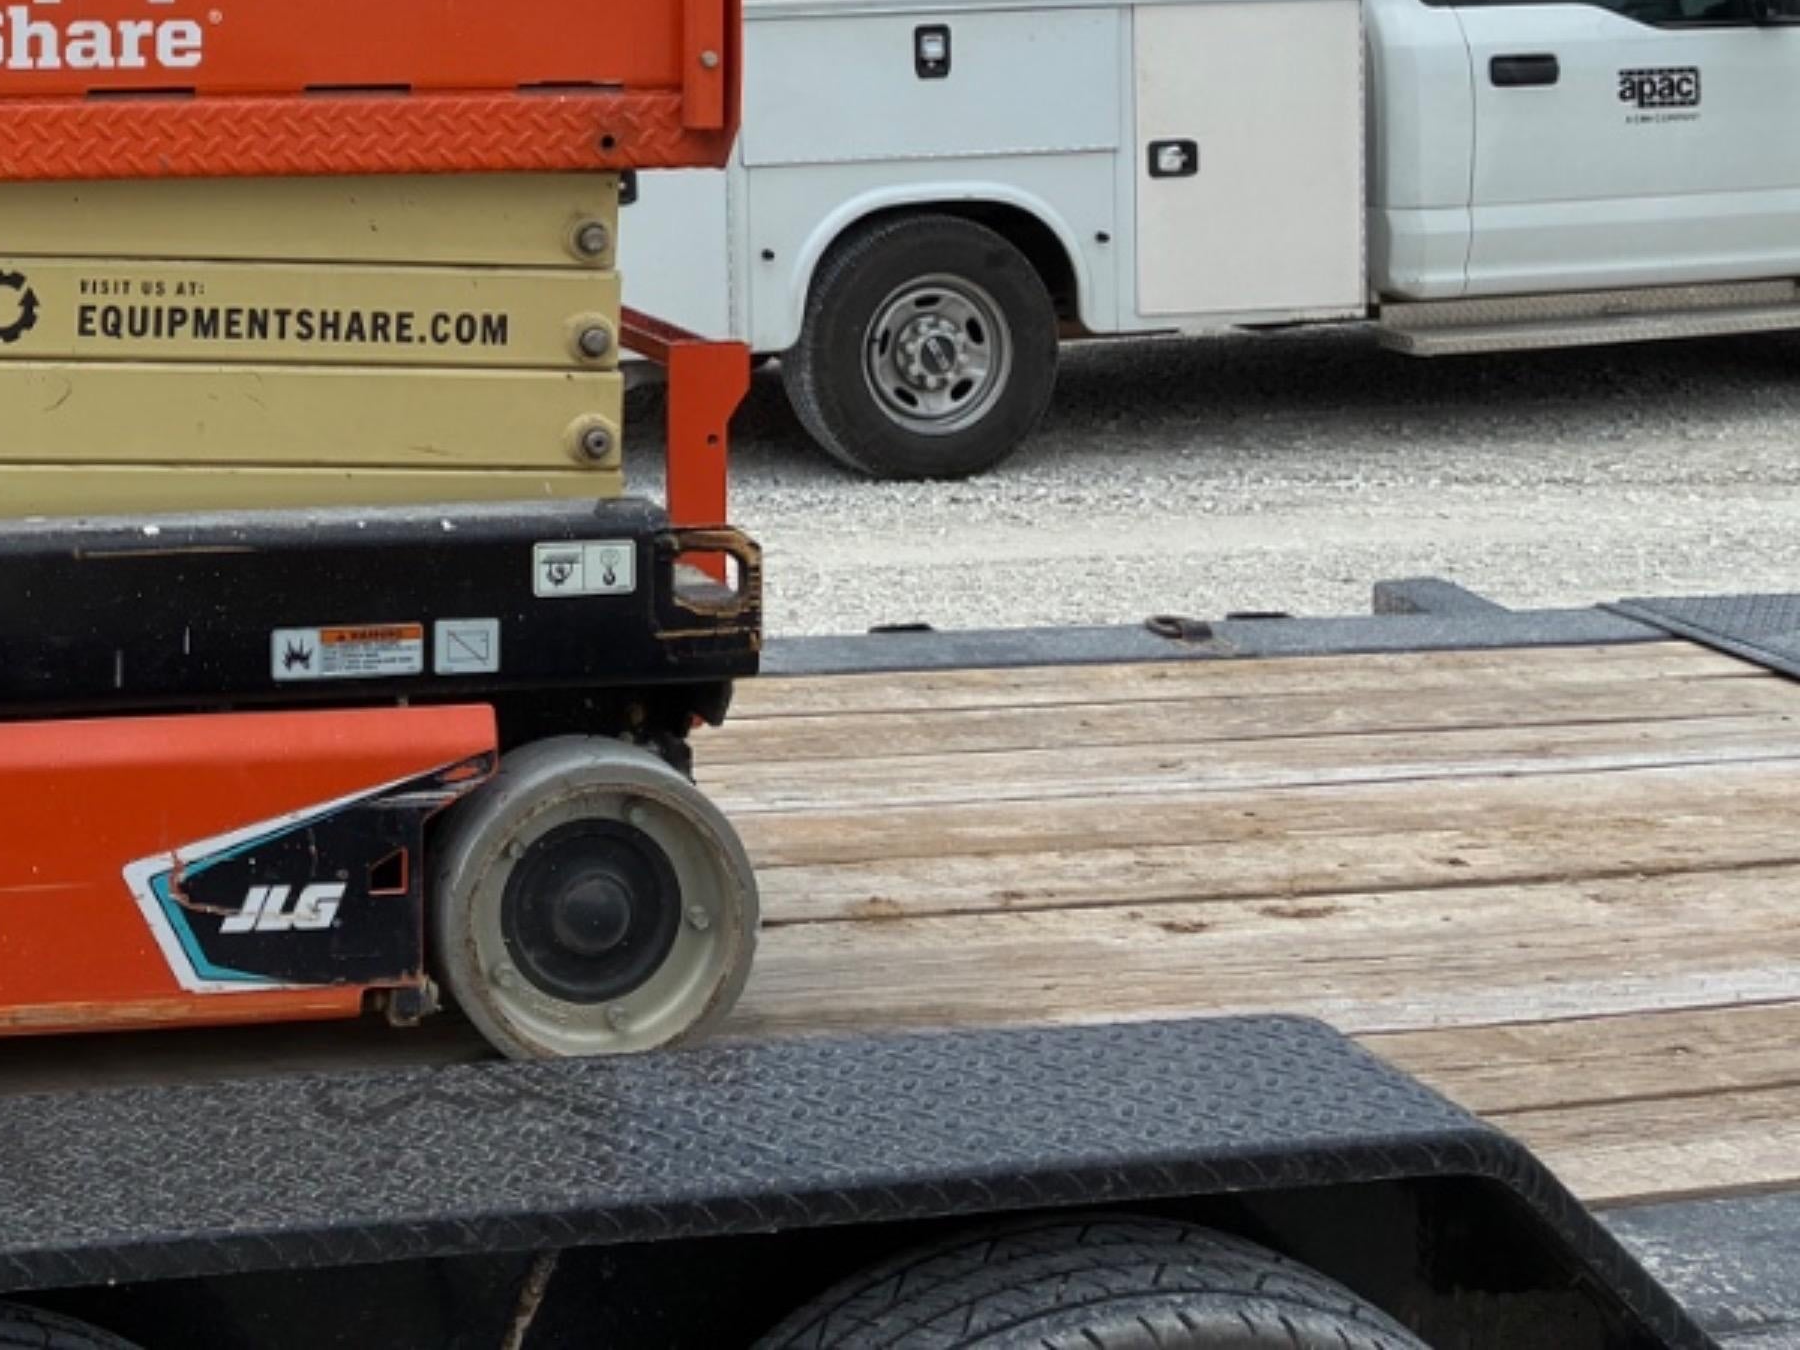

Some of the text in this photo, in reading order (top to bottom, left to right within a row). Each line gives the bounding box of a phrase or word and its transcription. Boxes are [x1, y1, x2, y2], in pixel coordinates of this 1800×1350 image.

[1617, 75, 1694, 108] apac
[80, 278, 206, 297] VISIT US AT:
[77, 304, 510, 346] EQUIPMENTSHARE.COM
[219, 882, 348, 934] JLG
